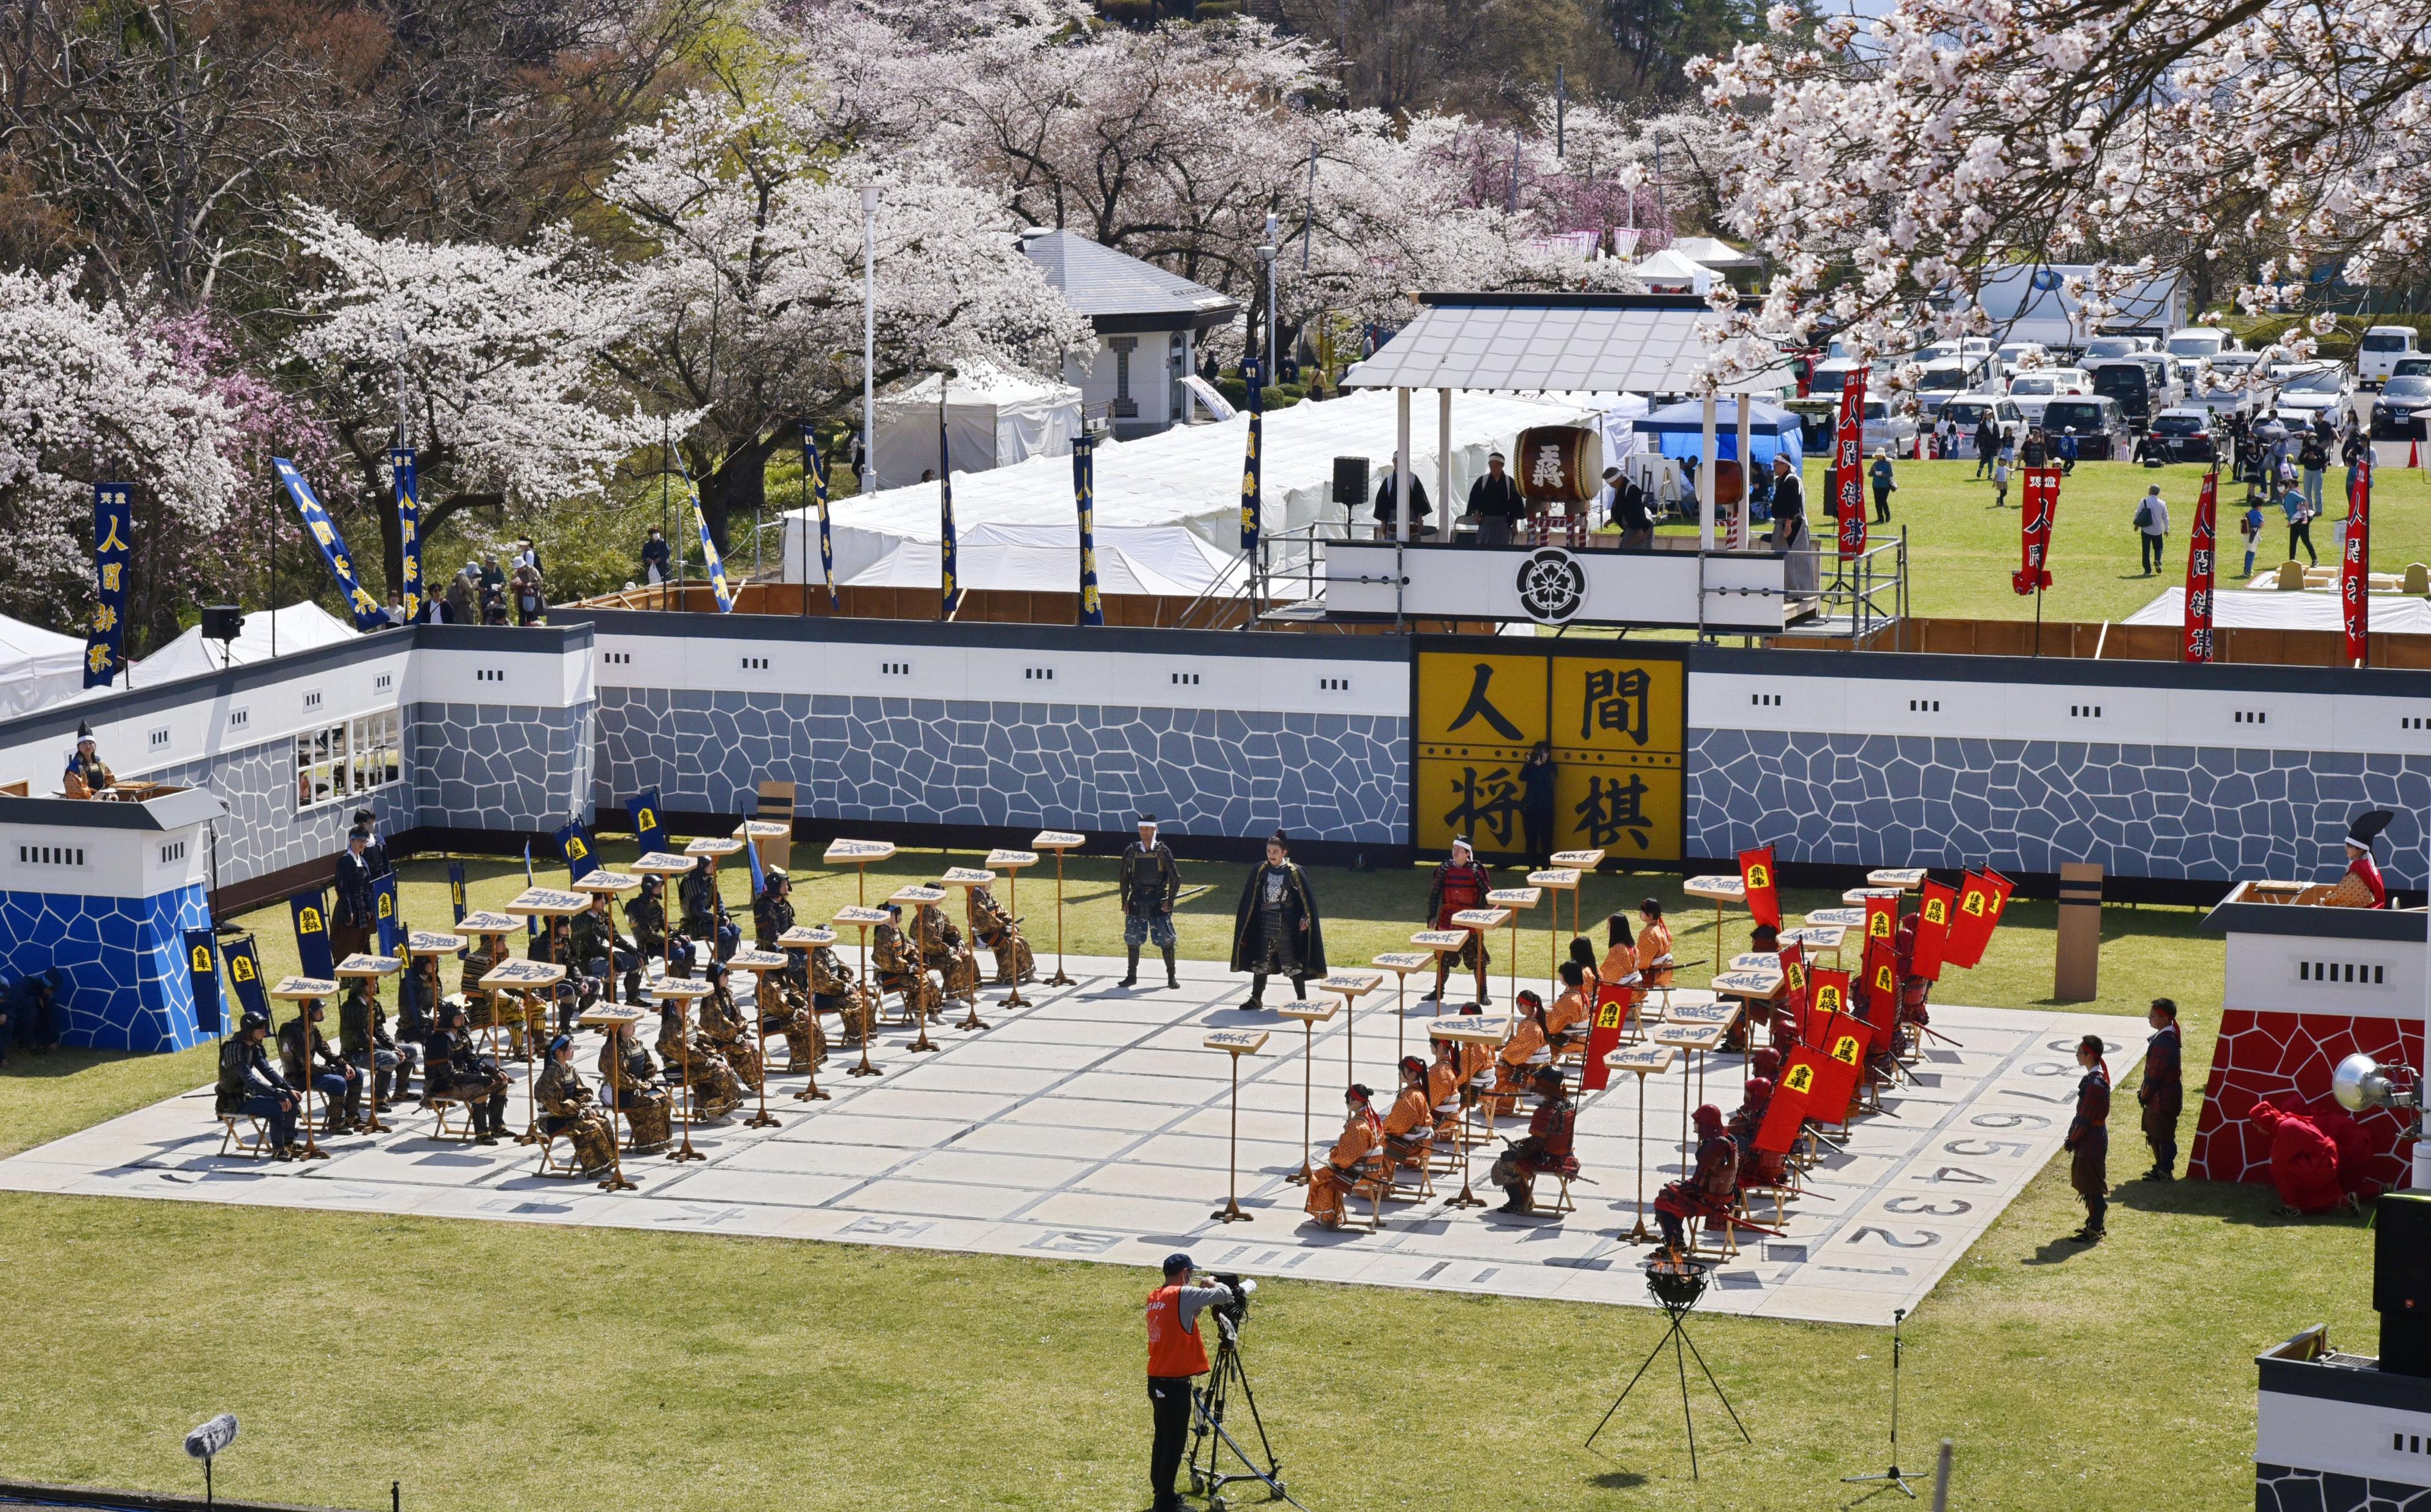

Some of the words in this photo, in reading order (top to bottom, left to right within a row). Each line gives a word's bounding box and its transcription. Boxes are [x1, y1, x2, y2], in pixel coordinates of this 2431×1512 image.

[88, 514, 129, 675] 人間将棋
[1446, 662, 1651, 746] 人間
[1443, 766, 1653, 850] 将棋
[1965, 893, 1981, 914] 桂馬
[1600, 1003, 1617, 1026] 角行
[1835, 1038, 1855, 1062] 桂馬
[1787, 1067, 1810, 1089] 香車
[1998, 1089, 2079, 1105] 7
[1971, 1113, 2052, 1130] 6
[1943, 1139, 2032, 1157] 5
[1911, 1166, 1997, 1185] 4
[1883, 1196, 1972, 1216] 3
[1019, 1230, 1127, 1254] 四
[1845, 1226, 1941, 1249] 2
[1818, 1265, 1910, 1276] 1
